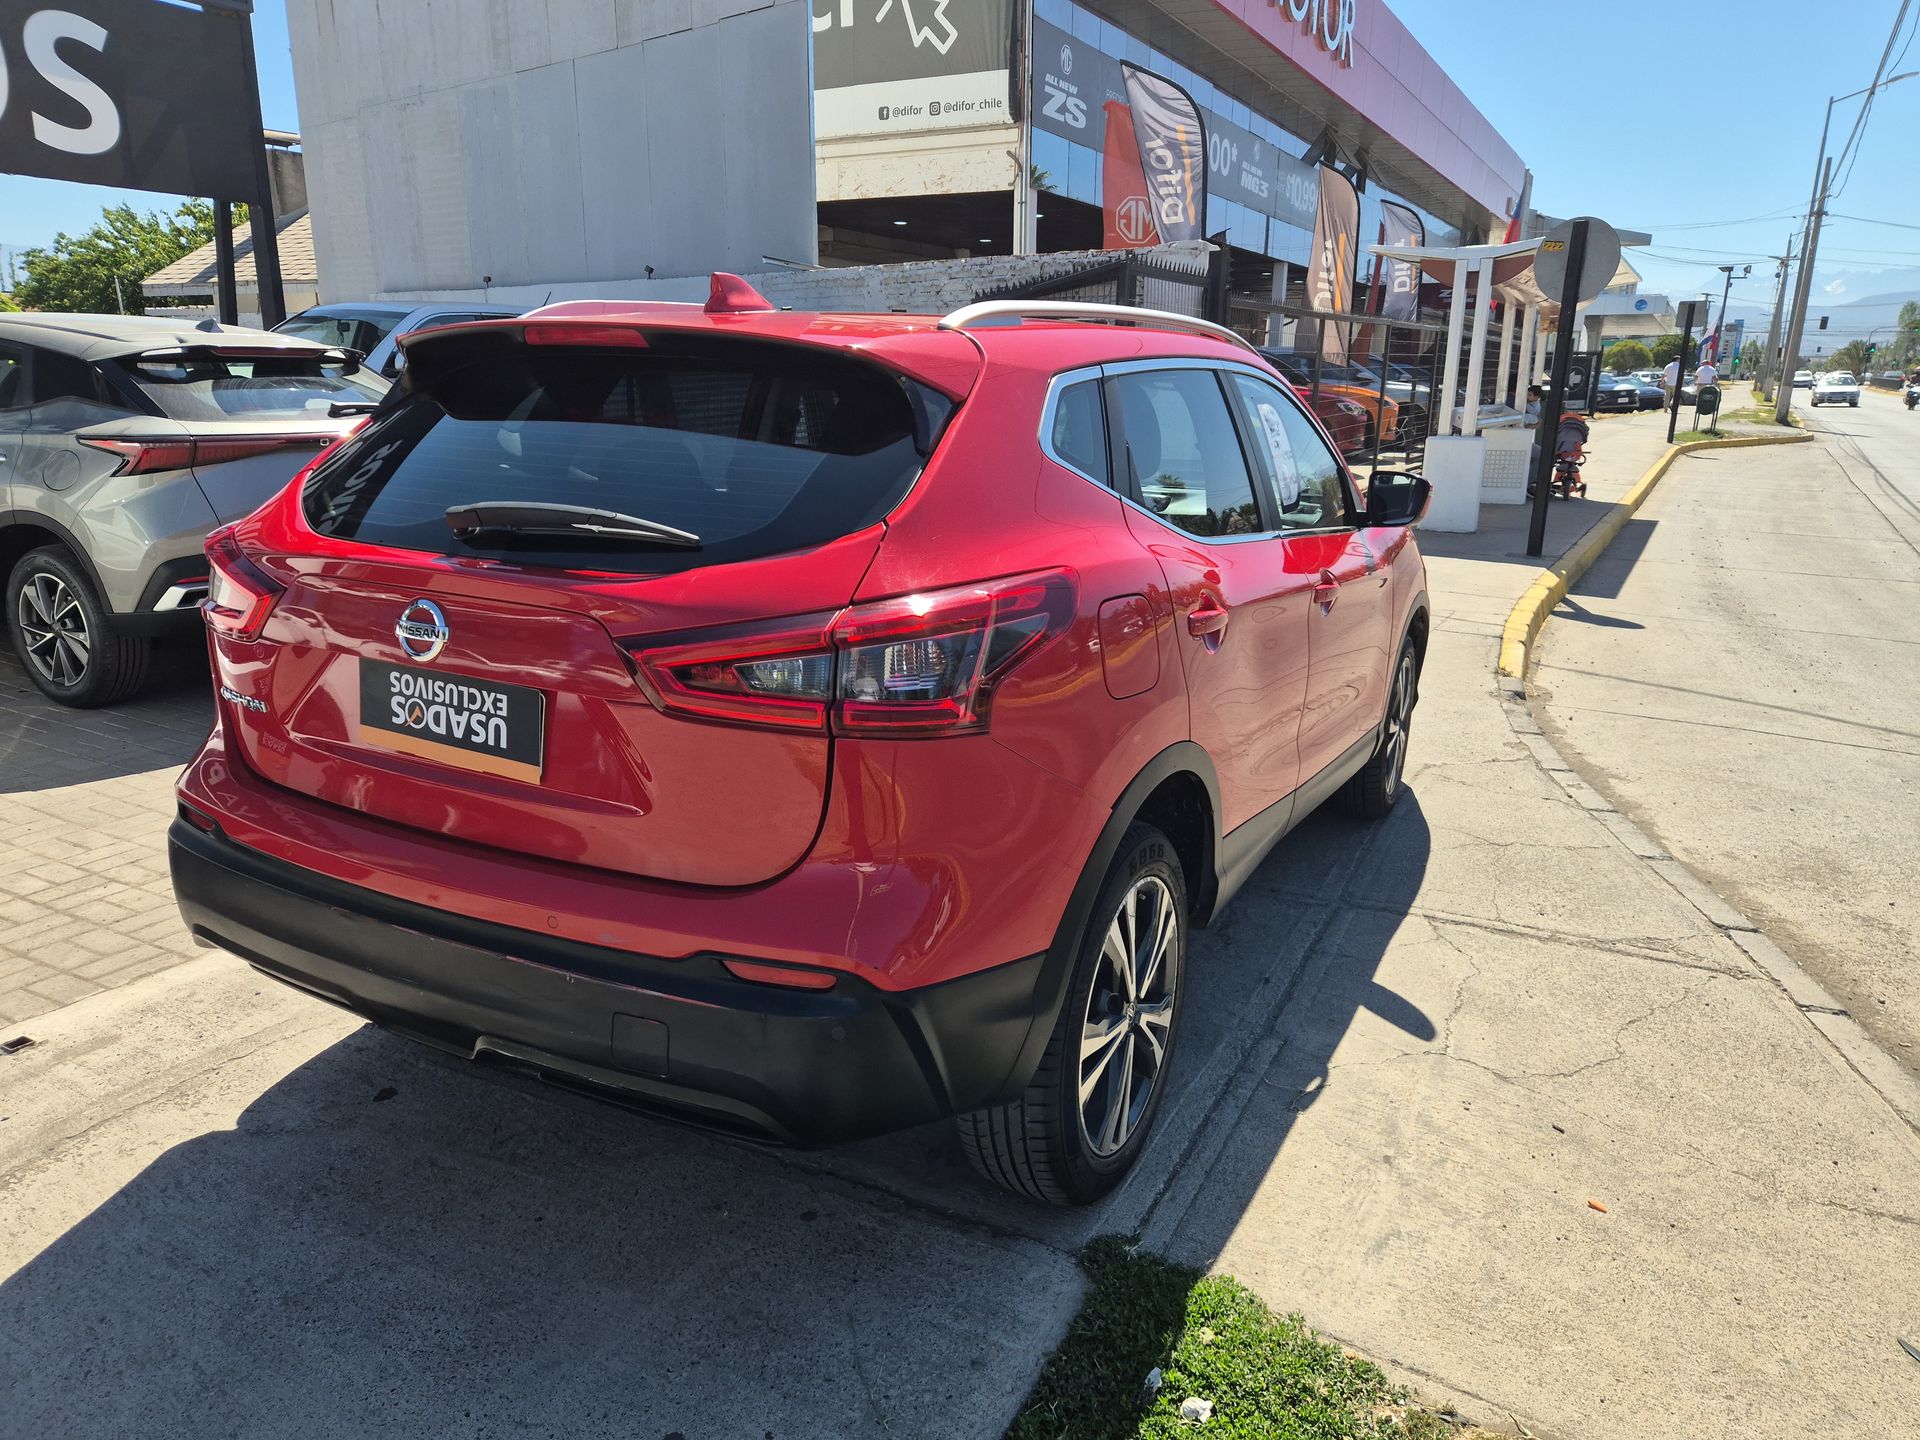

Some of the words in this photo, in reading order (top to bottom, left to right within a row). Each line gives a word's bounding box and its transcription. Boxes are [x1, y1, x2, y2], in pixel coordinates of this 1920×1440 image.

[0, 9, 121, 155] S
[1044, 73, 1058, 87] ALL
[1058, 80, 1078, 95] NEW
[892, 105, 923, 118] @difor
[943, 98, 1002, 114] @difor_chile
[1042, 85, 1087, 129] ZS
[1241, 172, 1269, 198] MG3
[398, 622, 441, 639] NISSAN
[389, 671, 508, 717] EXCLUSIVOS
[390, 695, 508, 749] USADOS
